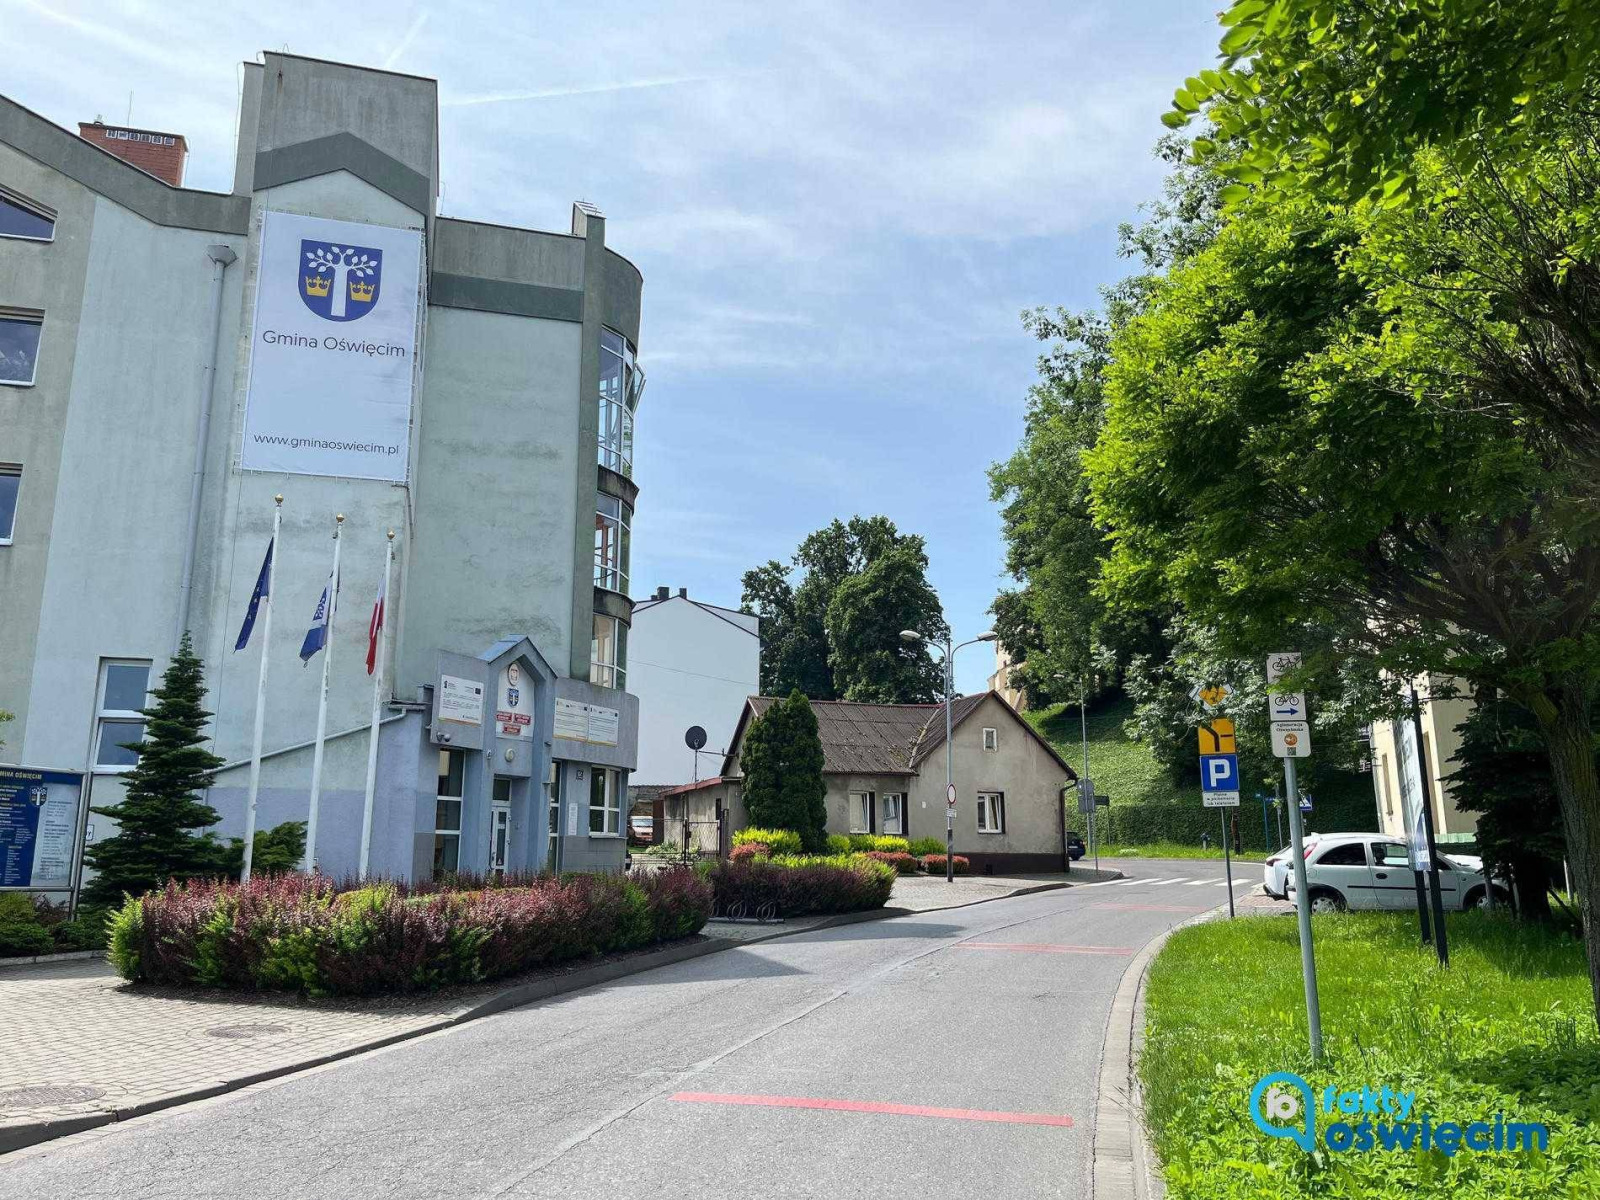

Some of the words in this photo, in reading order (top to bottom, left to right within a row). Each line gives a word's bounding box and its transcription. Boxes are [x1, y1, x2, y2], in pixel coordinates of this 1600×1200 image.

[263, 330, 318, 349] Gmina
[323, 336, 405, 357] Oświęcim
[253, 433, 399, 456] www.gminaoswiecim.pl
[1209, 759, 1231, 787] P
